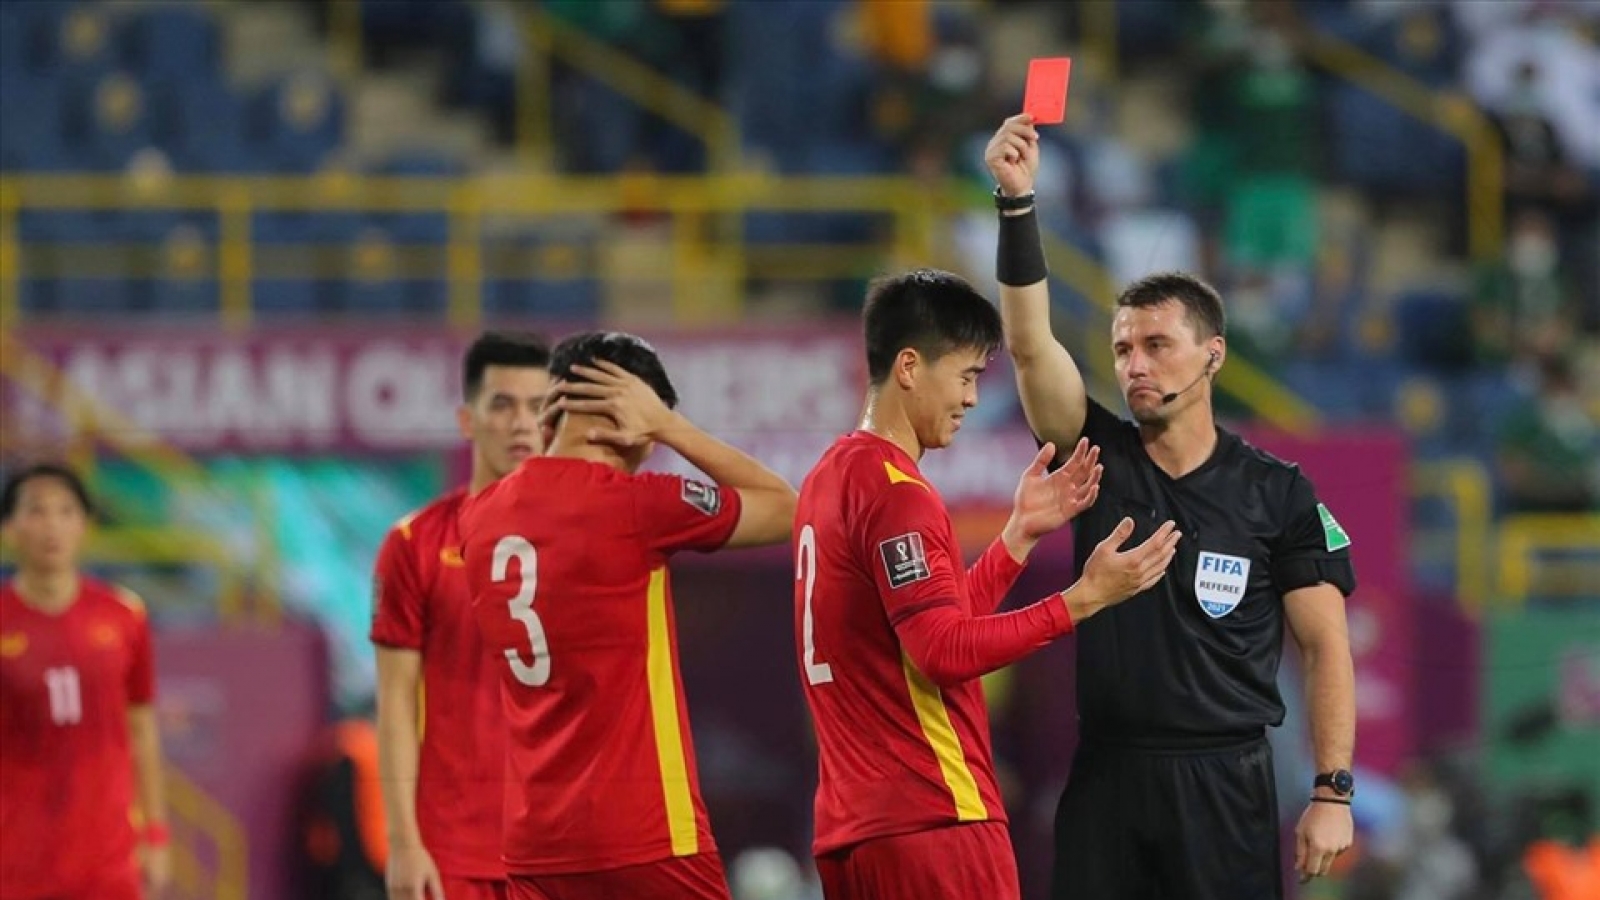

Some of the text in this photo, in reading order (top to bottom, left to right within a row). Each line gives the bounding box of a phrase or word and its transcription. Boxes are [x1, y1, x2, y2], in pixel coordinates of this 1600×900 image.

[1199, 580, 1241, 595] REFEREE
[1202, 556, 1243, 576] FIFA
[491, 534, 551, 686] 3
[797, 524, 834, 686] 2
[43, 665, 83, 727] 11
